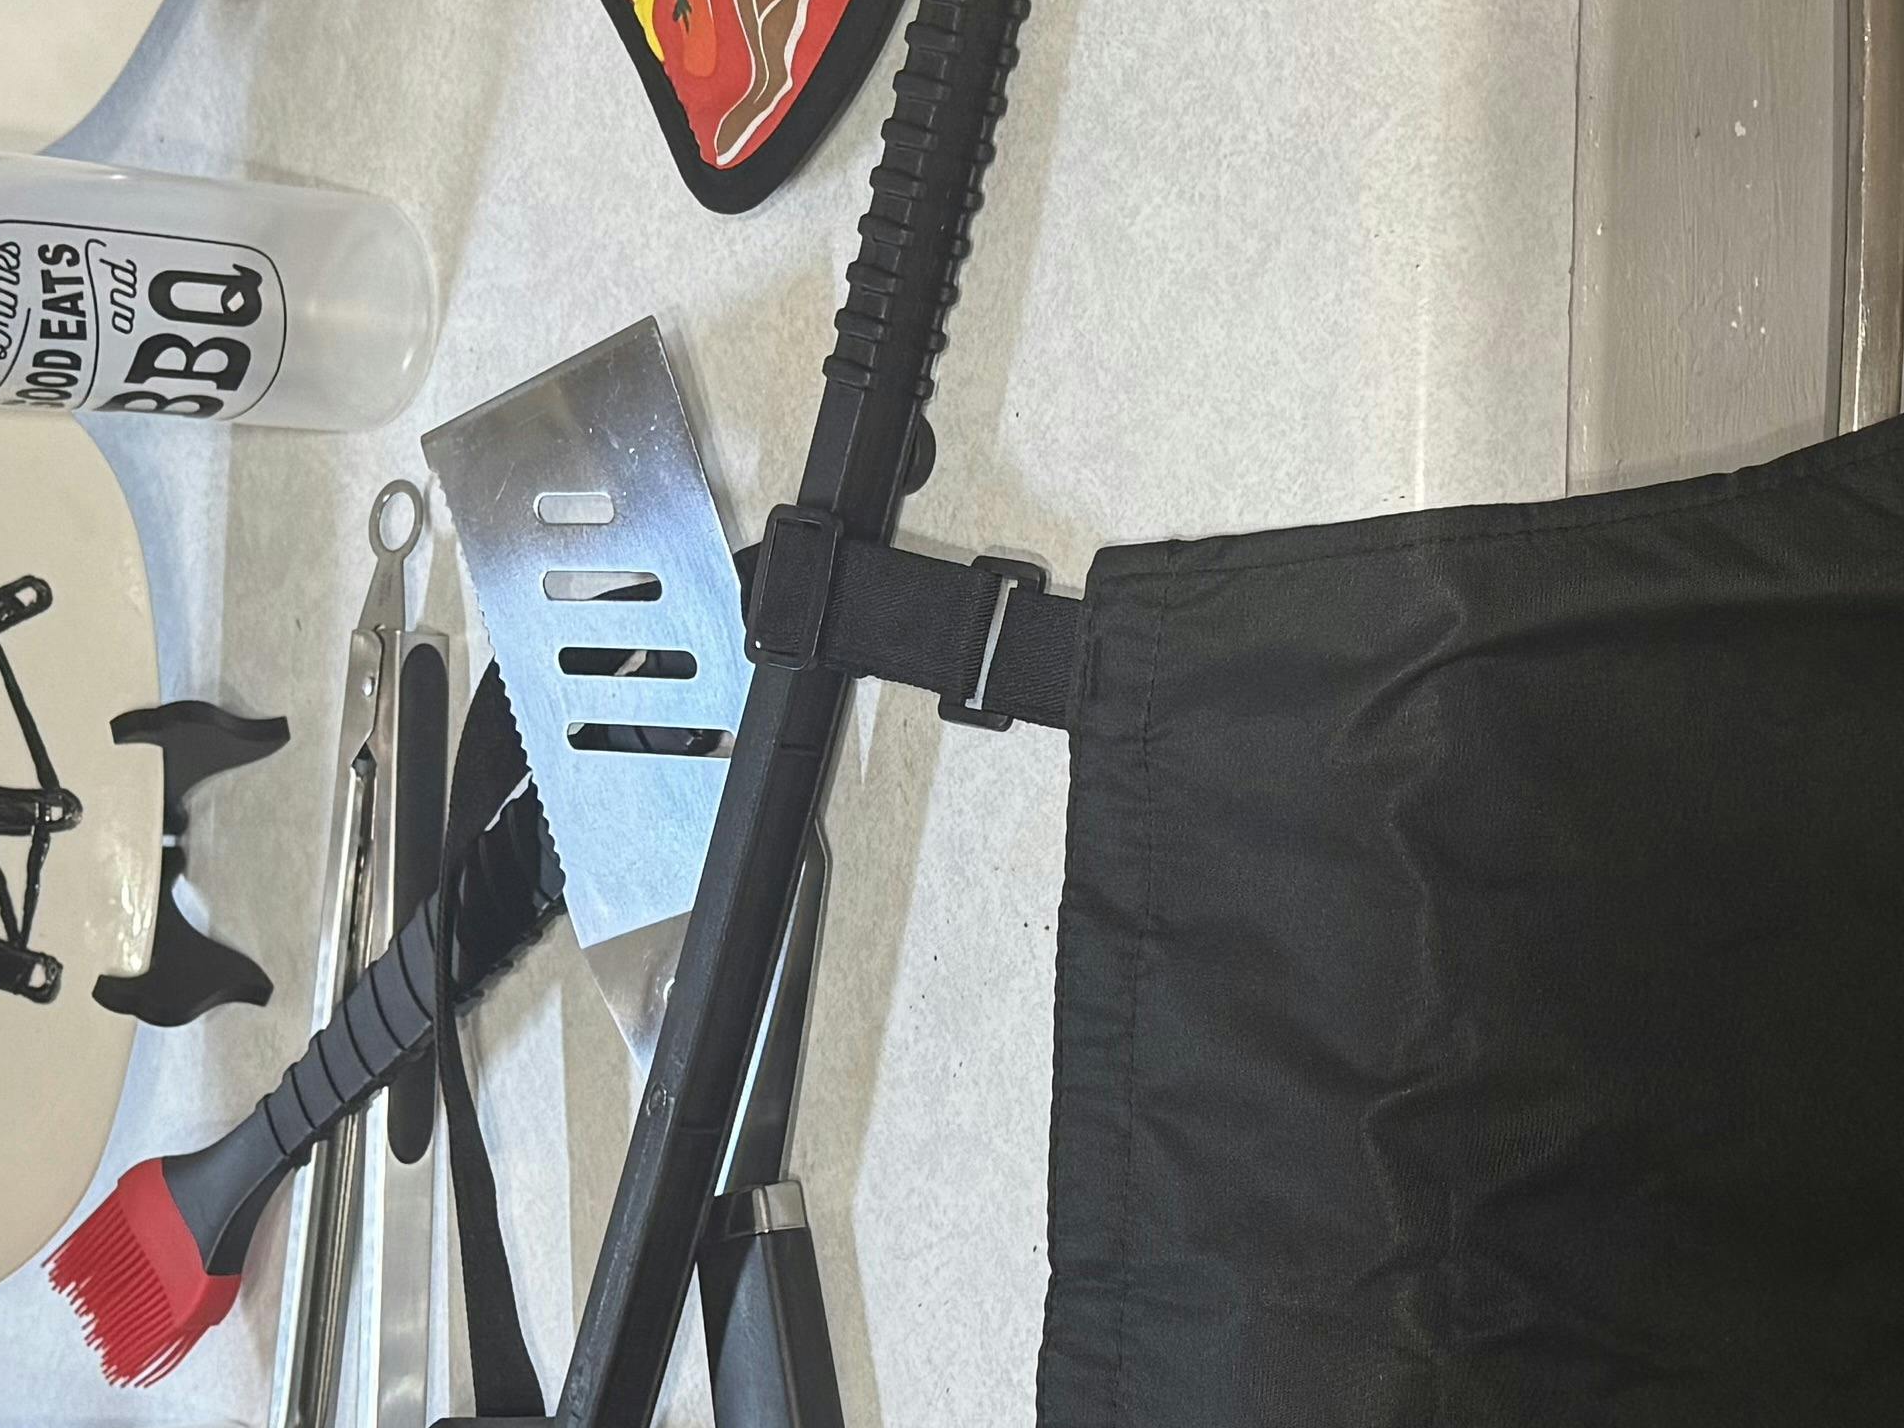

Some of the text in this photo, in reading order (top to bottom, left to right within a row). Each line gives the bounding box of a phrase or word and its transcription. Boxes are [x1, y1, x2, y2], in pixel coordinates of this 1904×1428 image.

[38, 244, 88, 340] EATS
[100, 259, 137, 335] and
[94, 263, 263, 419] BBQ
